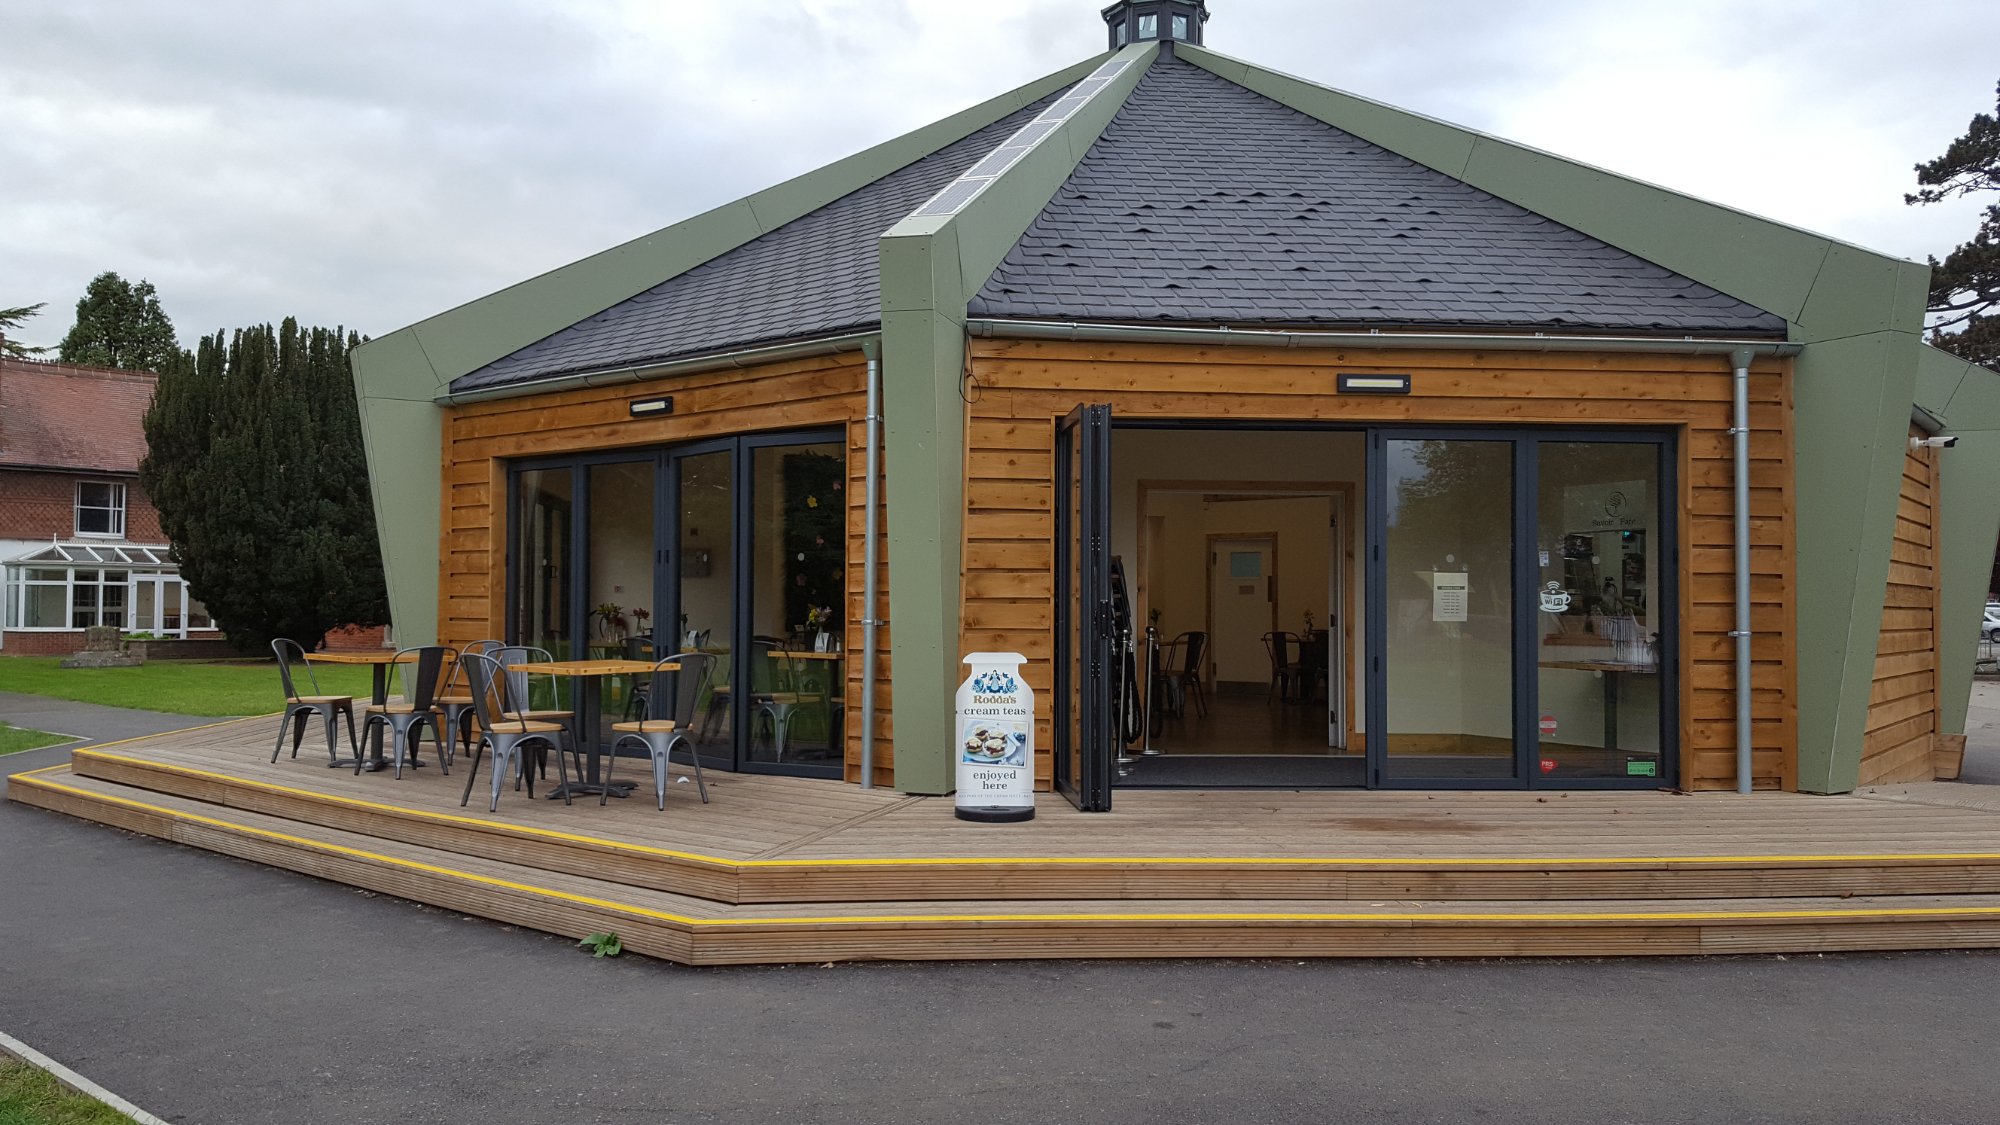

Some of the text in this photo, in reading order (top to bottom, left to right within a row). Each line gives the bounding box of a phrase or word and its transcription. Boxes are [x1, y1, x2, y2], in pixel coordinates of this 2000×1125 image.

[973, 695, 1017, 704] Rodda's
[964, 707, 1026, 715] cream teas
[973, 770, 1017, 781] enjoyed
[982, 781, 1008, 790] here
